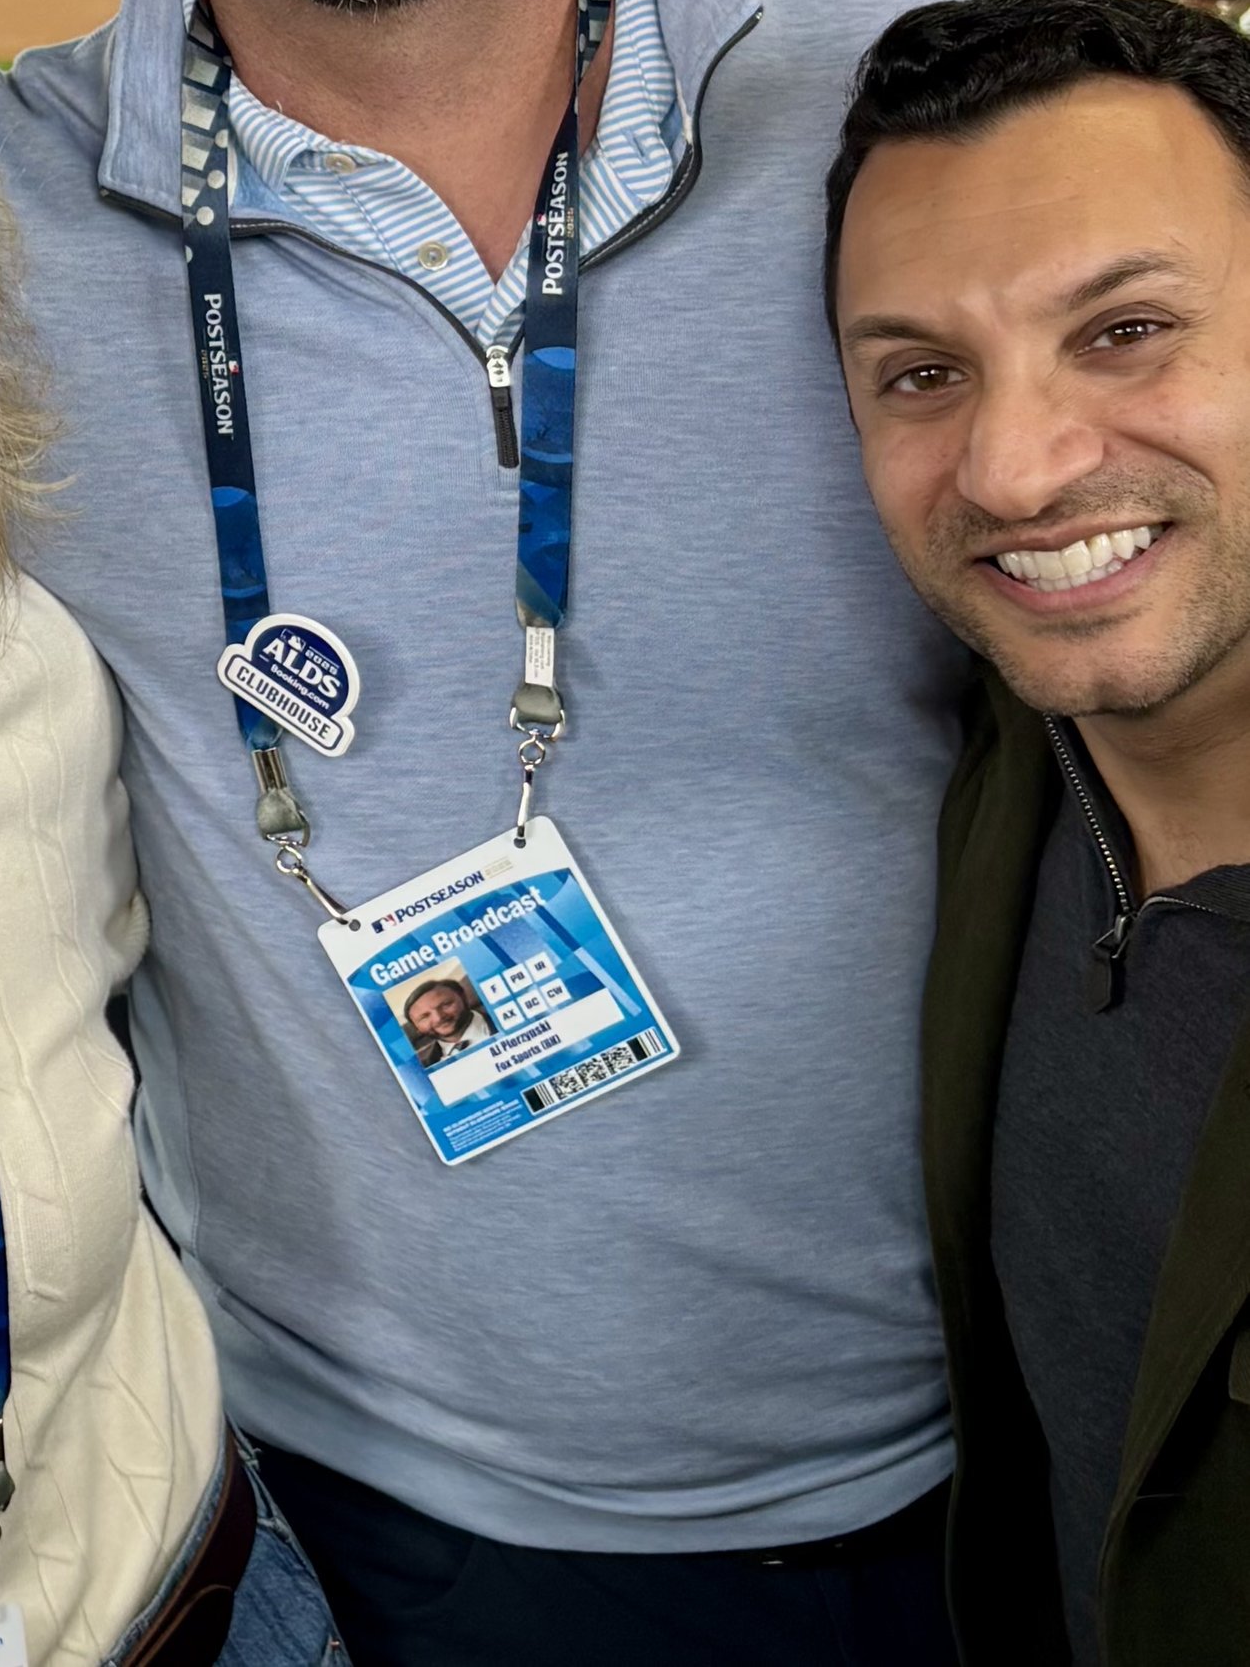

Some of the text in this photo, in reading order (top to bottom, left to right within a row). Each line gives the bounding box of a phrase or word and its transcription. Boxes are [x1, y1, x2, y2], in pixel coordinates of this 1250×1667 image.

[542, 151, 569, 295] POSTSEASON
[204, 294, 234, 435] POSTSEASON
[262, 638, 342, 698] ALDS
[270, 664, 330, 709] Booking.com
[236, 666, 331, 740] CLUBHOUSE
[394, 870, 485, 923] POSTSEASON
[370, 885, 547, 986] Game Broadcast
[502, 1009, 517, 1021] AX
[546, 986, 563, 999] CW
[510, 1045, 542, 1065] Sports
